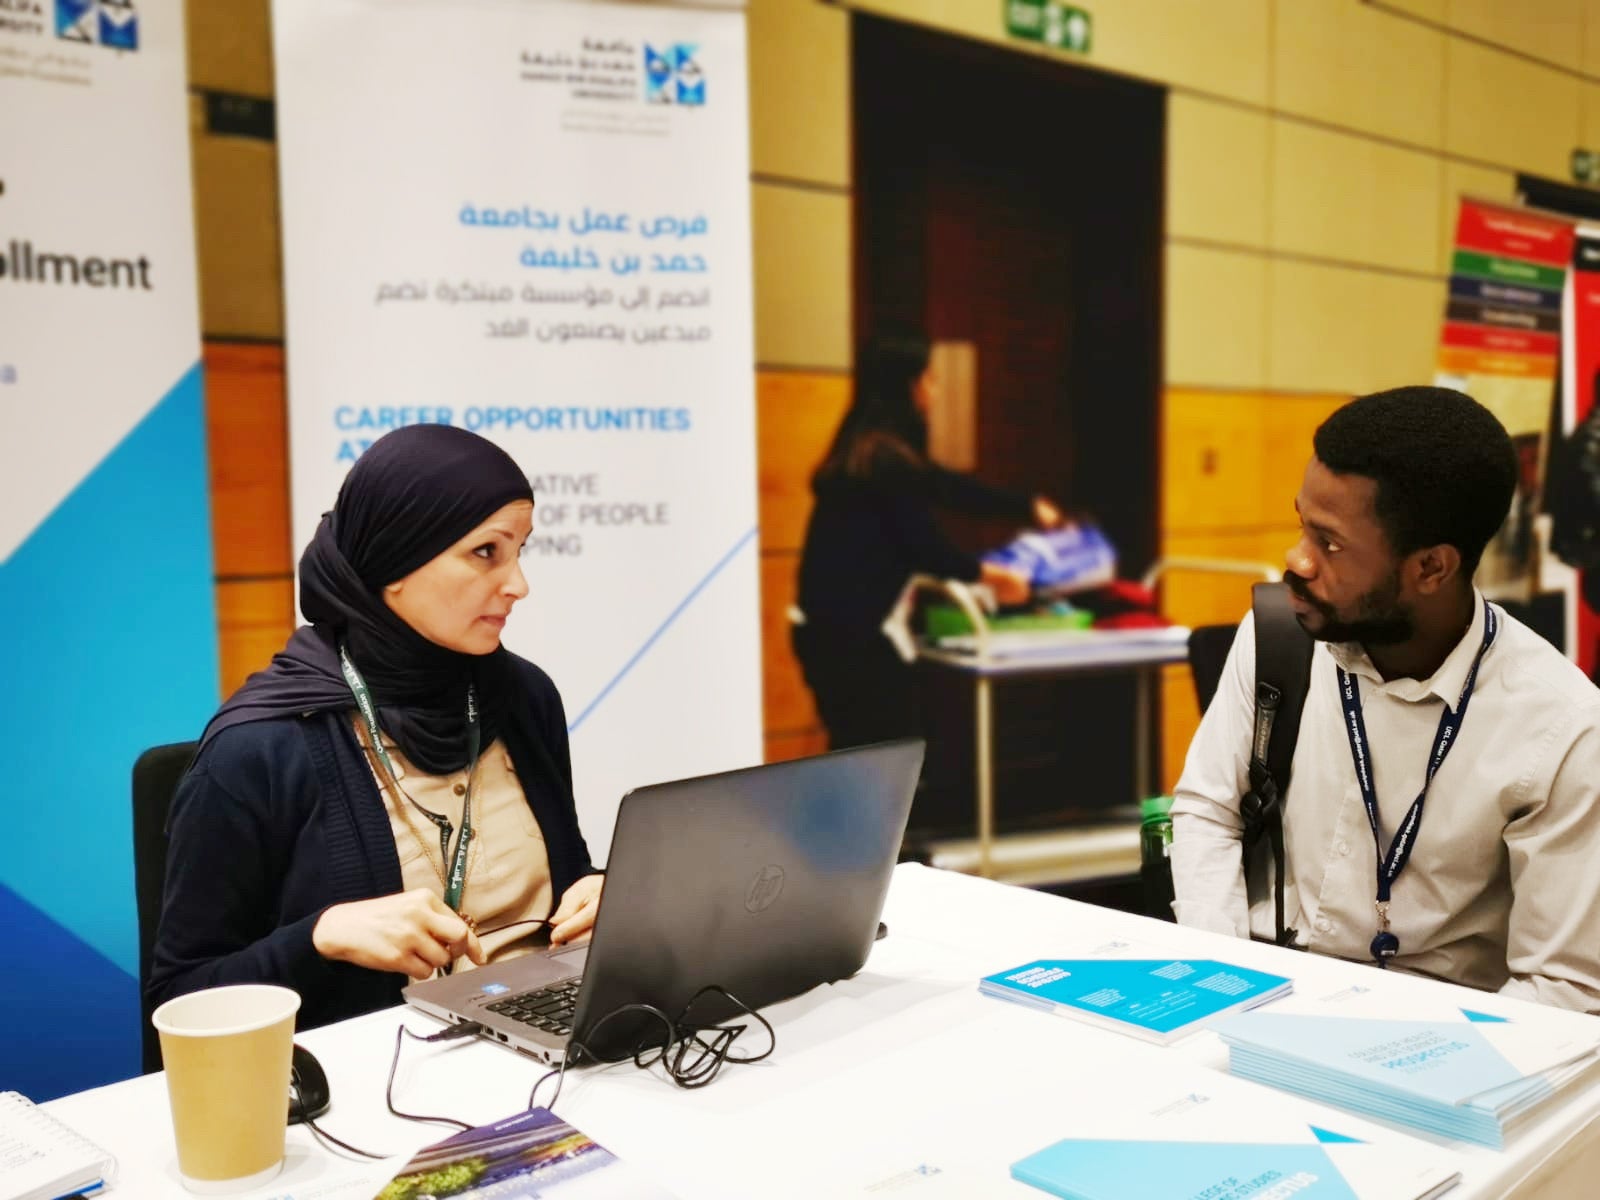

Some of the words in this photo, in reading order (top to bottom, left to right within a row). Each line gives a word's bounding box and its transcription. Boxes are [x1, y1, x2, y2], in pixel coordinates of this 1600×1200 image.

[458, 202, 561, 232] بجامعة
[568, 208, 631, 235] عمل
[640, 213, 708, 239] فرص
[519, 243, 601, 273] خليفة
[650, 252, 708, 273] حمد
[464, 408, 691, 432] OPPORTUNITIES
[539, 504, 572, 526] OF
[579, 504, 669, 526] PEOPLE
[360, 692, 377, 733] Foundation
